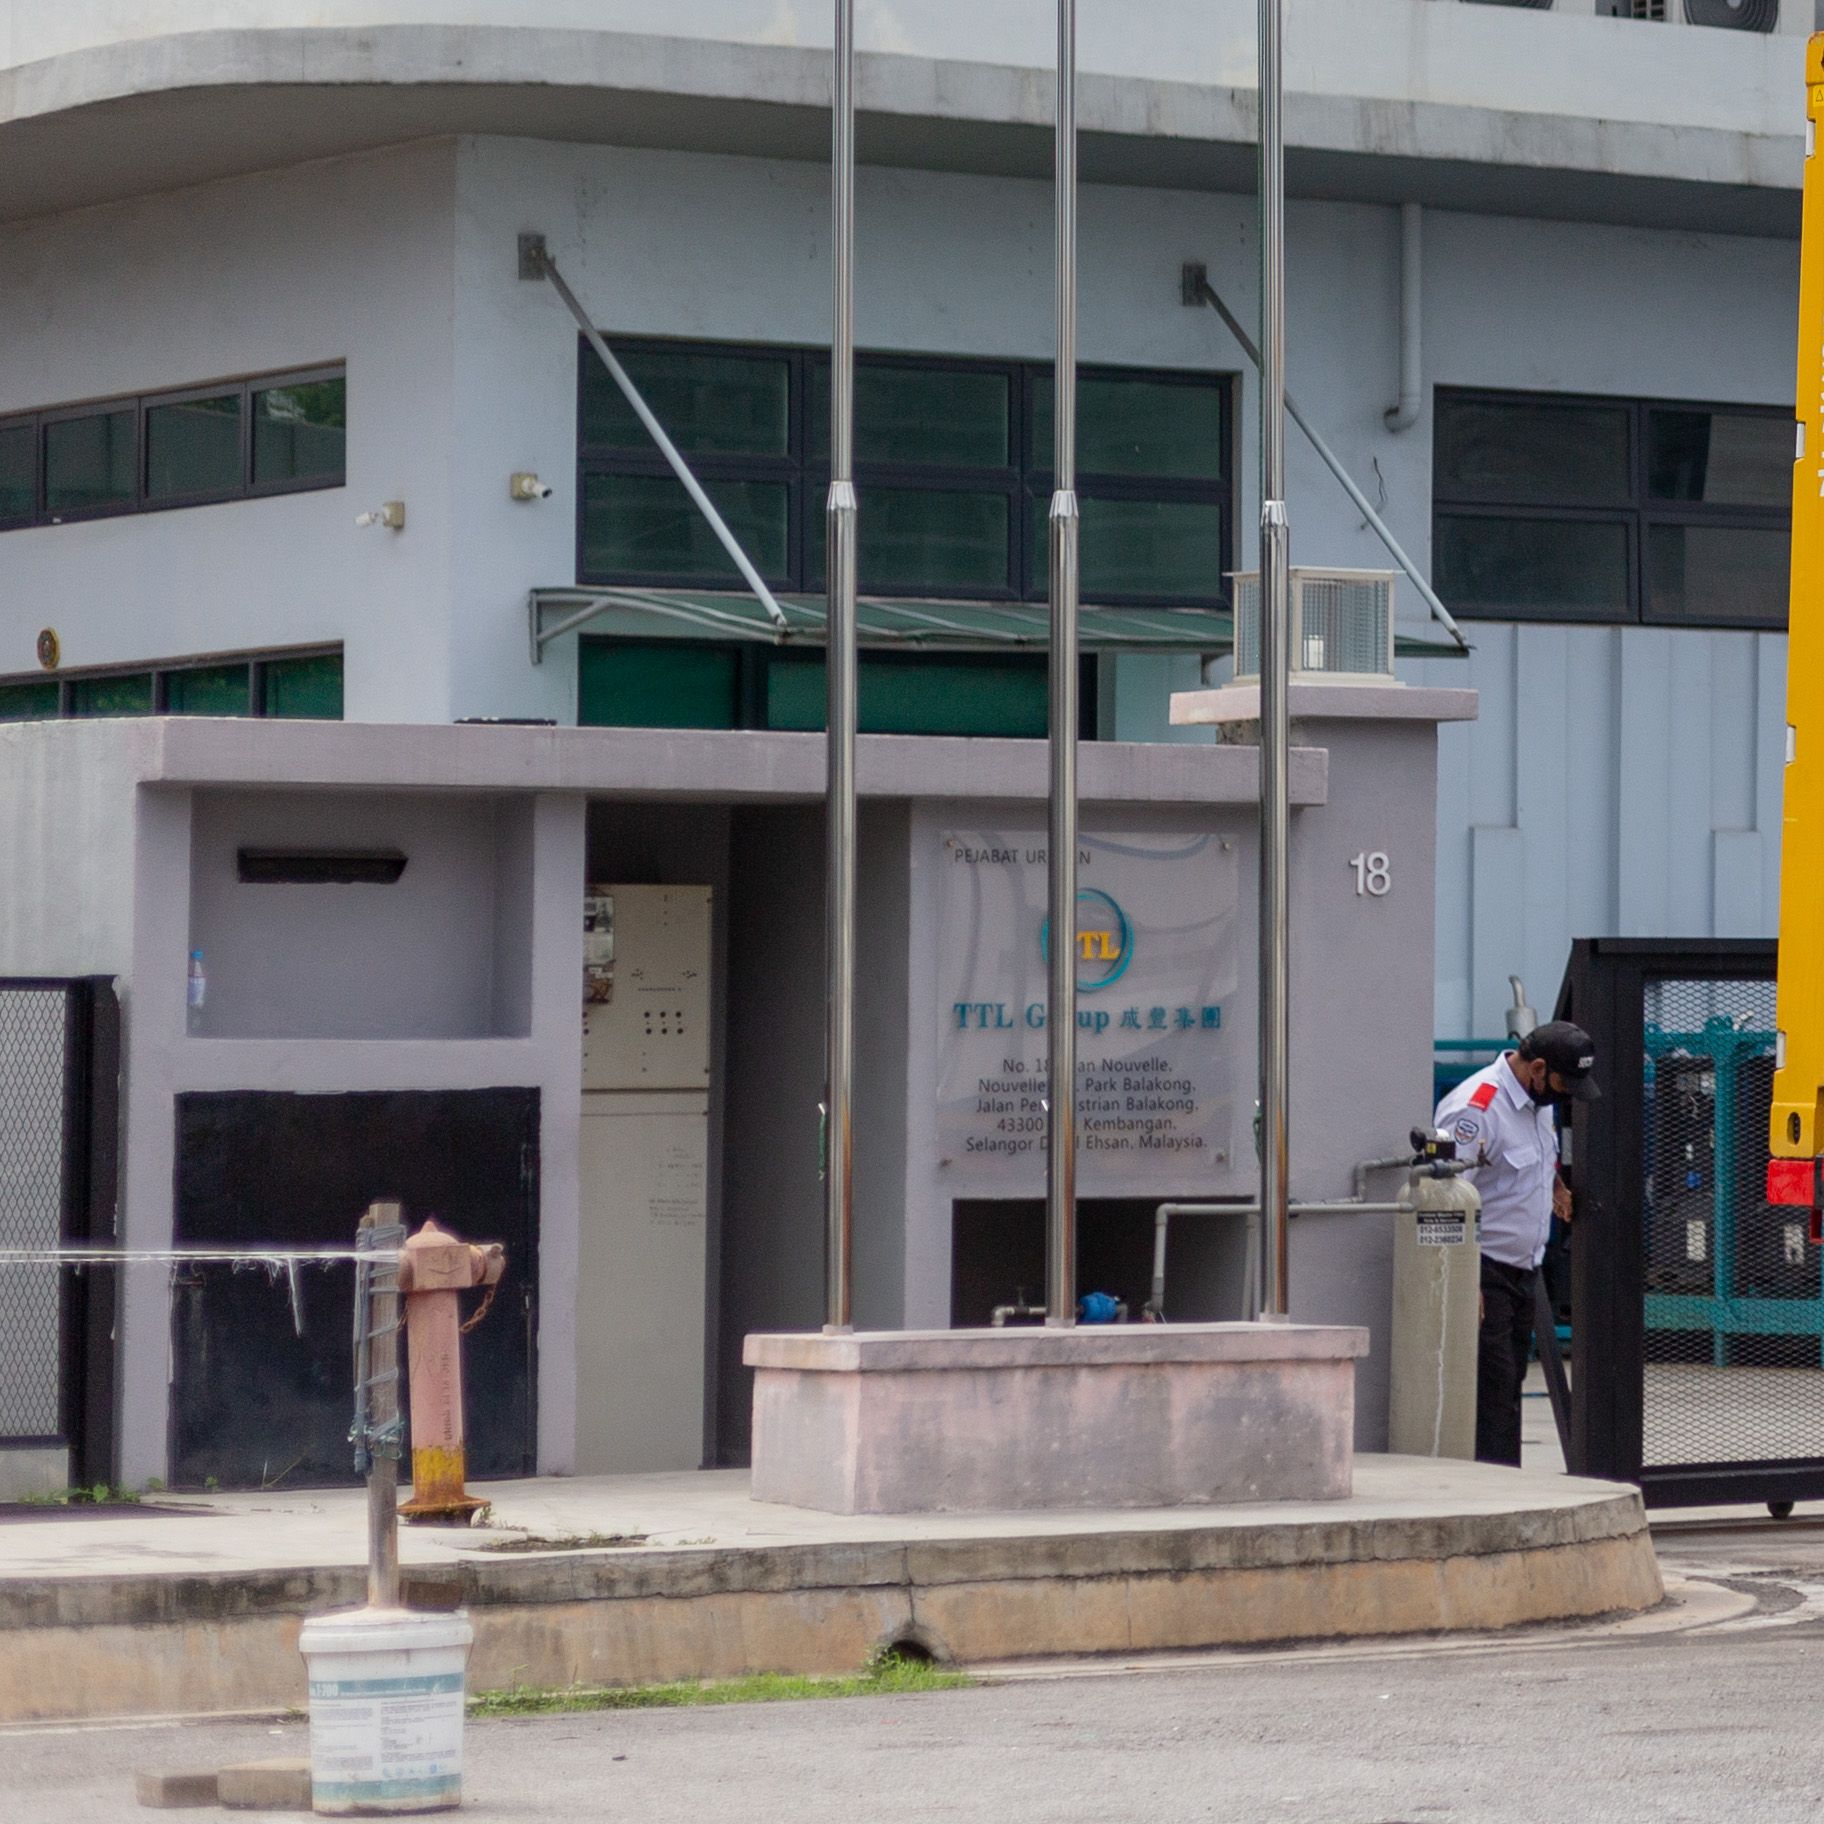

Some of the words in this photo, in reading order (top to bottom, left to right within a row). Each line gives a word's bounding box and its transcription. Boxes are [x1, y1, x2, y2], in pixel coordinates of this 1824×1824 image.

[954, 848, 1019, 864] PEJABAT
[1026, 848, 1091, 865] URN
[1350, 852, 1392, 897] 18
[1076, 931, 1121, 961] TL
[953, 1003, 1014, 1028] TTL
[1025, 1002, 1110, 1035] Gup
[1085, 1077, 1117, 1092] Park
[976, 1098, 1014, 1113] Jalan
[997, 1117, 1044, 1132] 43300
[966, 1136, 1033, 1155] Selangor
